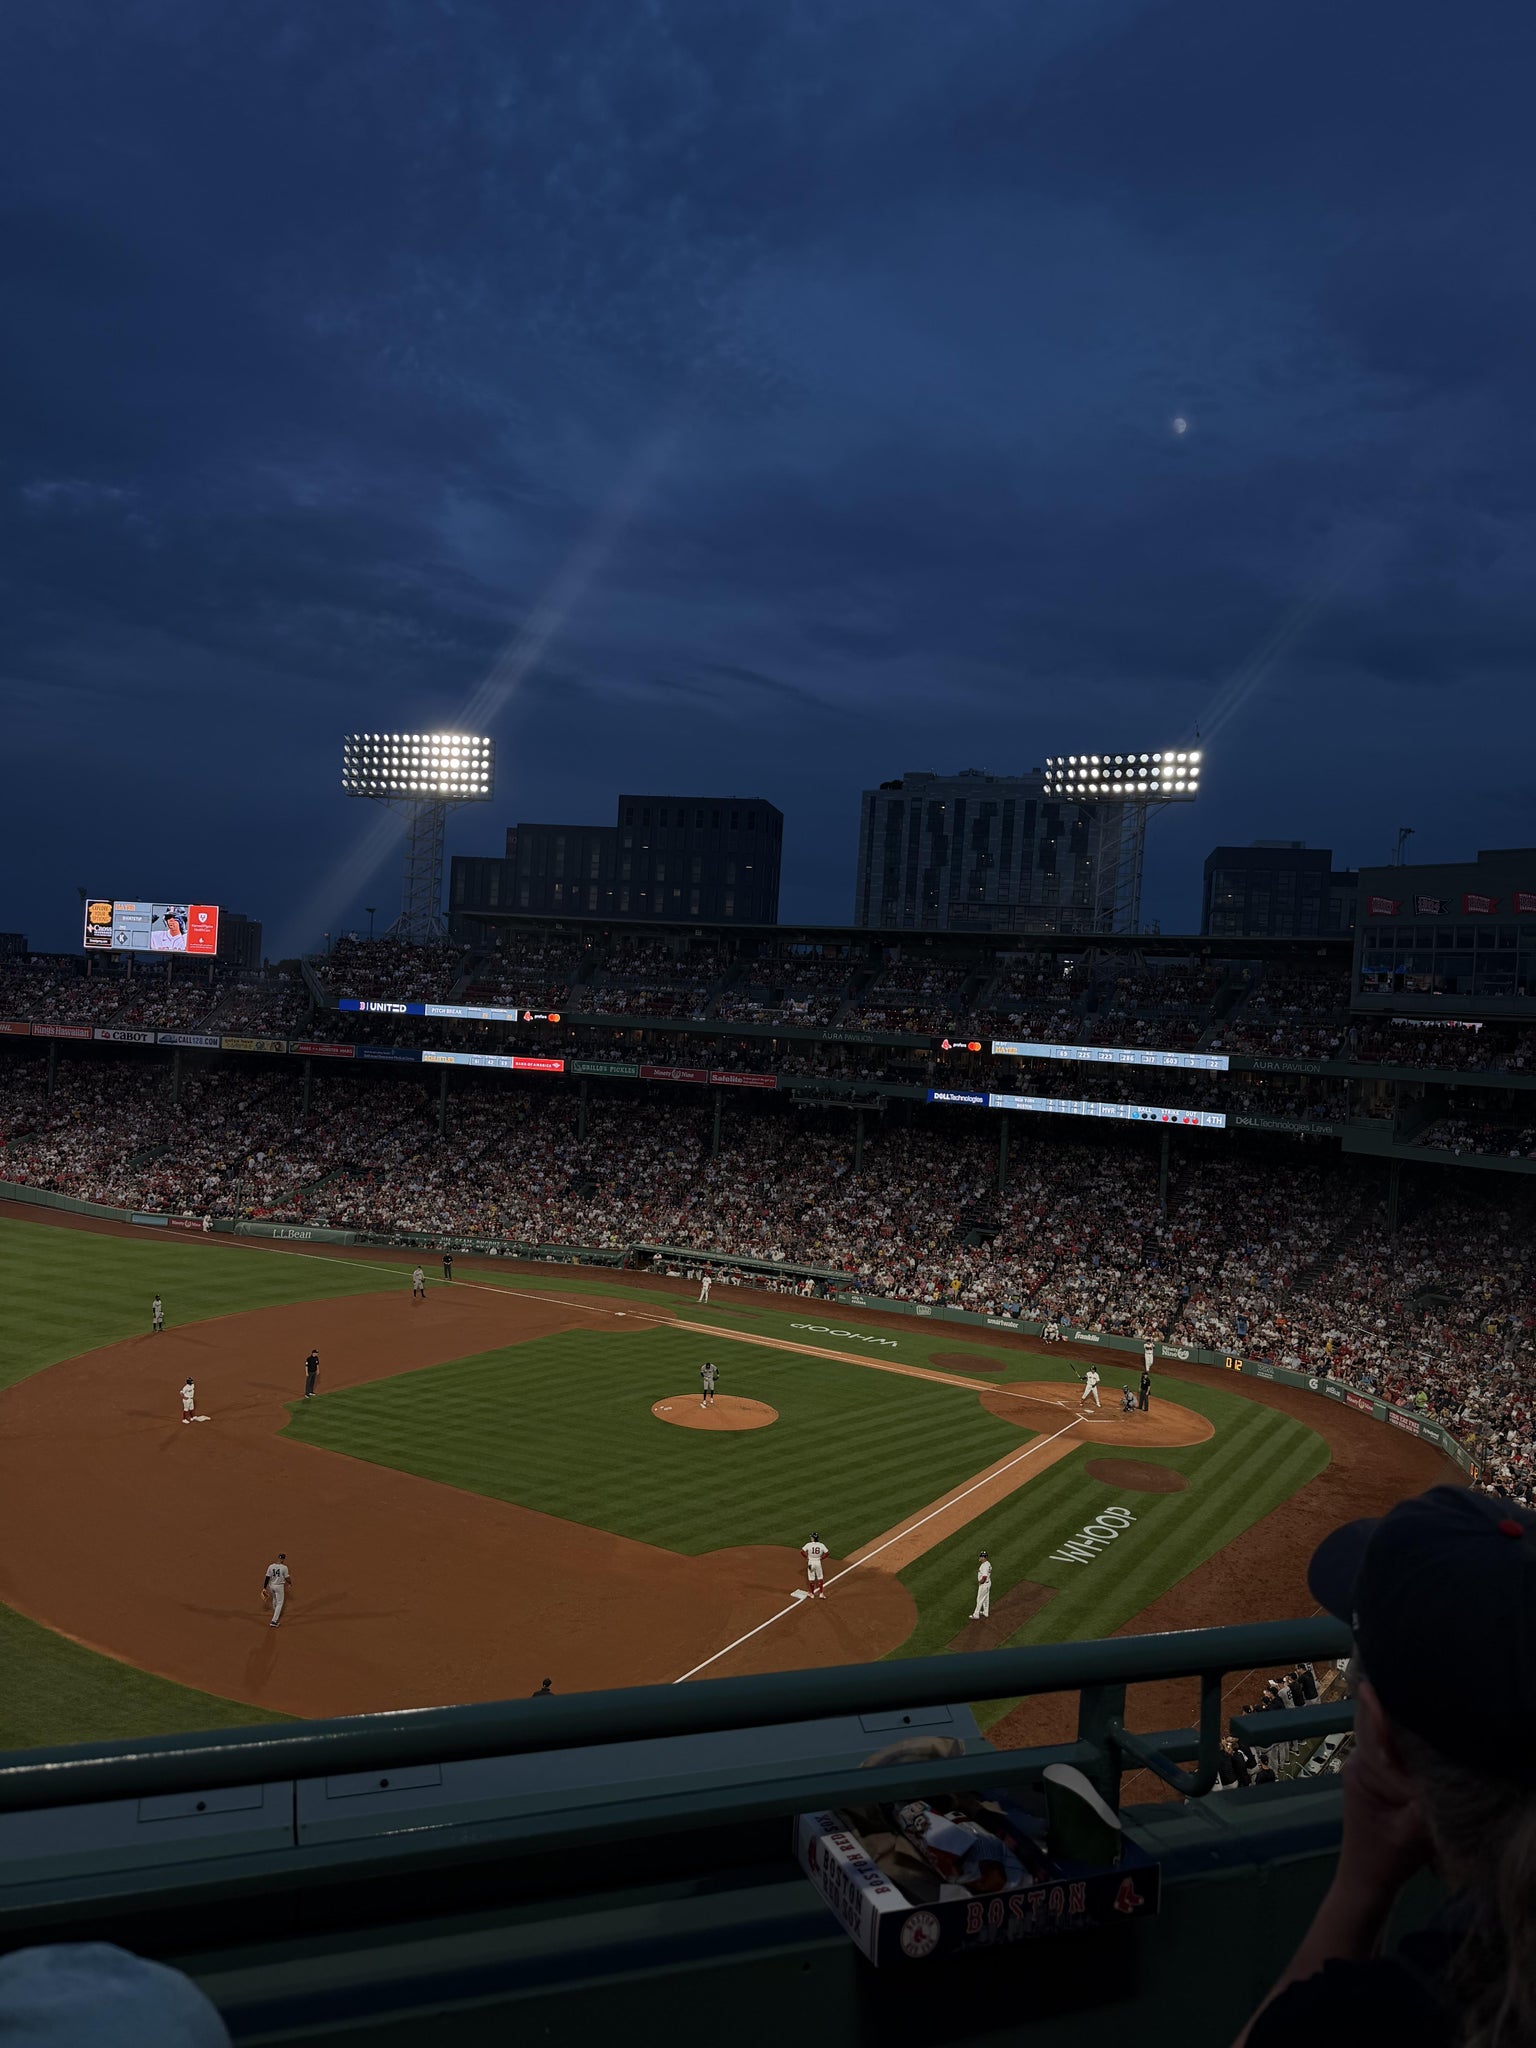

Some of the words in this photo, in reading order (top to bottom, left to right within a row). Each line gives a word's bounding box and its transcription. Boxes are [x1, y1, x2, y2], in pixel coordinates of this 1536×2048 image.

[370, 1002, 407, 1013] UNITED
[56, 1026, 90, 1037] Hawaiian
[609, 1065, 636, 1074] PICKLES
[1282, 1062, 1321, 1072] PAVILION
[654, 1069, 672, 1079] Ninety
[711, 1073, 744, 1084] Safelite
[934, 1092, 951, 1100] DELL
[950, 1094, 984, 1104] Technologies
[1206, 1115, 1222, 1124] 4TH
[1235, 1116, 1260, 1126] DELL
[1259, 1119, 1310, 1131] Technologies
[1311, 1123, 1333, 1133] Level
[273, 1228, 312, 1240] L.L.Bean
[987, 1318, 1020, 1329] smartwater
[790, 1322, 898, 1348] WHOOP
[1074, 1331, 1100, 1343] Franklin
[1234, 1360, 1243, 1370] 12
[1325, 1384, 1341, 1397] jetBlue
[1049, 1506, 1137, 1564] WHOOP
[815, 1814, 839, 1833] SOX
[831, 1833, 855, 1852] RED
[847, 1853, 892, 1894] BOSTON
[823, 1850, 863, 1915] BOSTON
[823, 1871, 840, 1908] RED
[842, 1893, 862, 1938] SOX
[966, 1881, 1088, 1936] BOSTON
